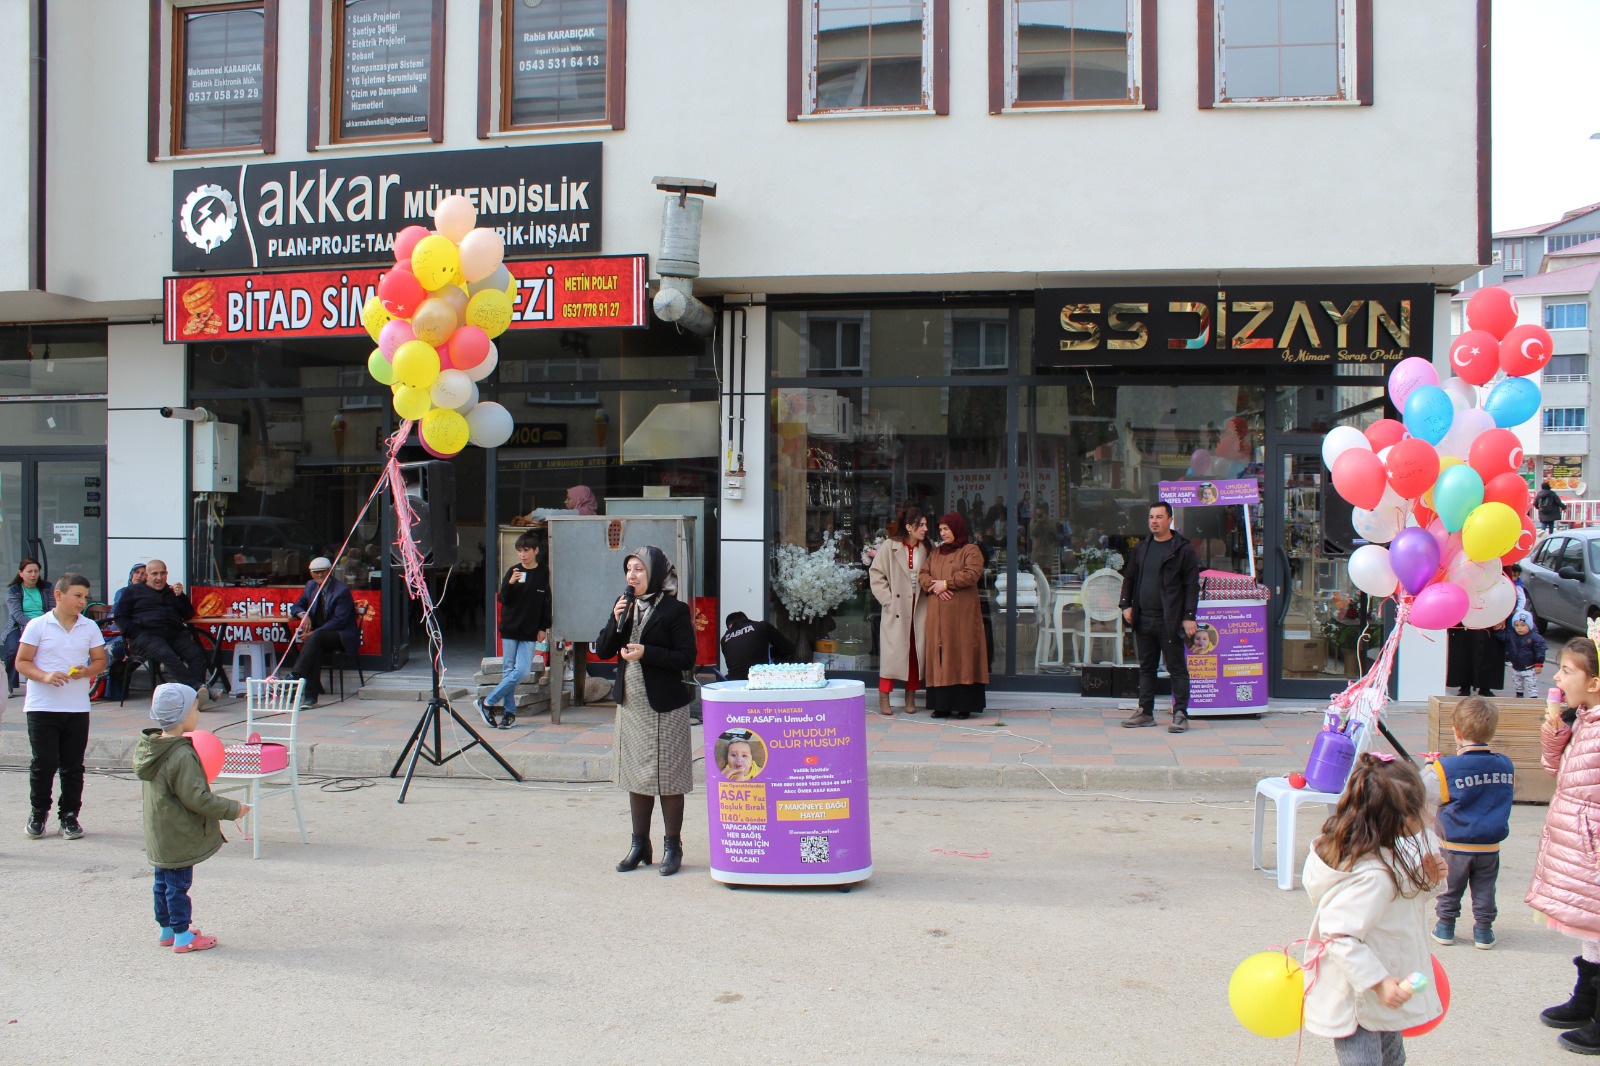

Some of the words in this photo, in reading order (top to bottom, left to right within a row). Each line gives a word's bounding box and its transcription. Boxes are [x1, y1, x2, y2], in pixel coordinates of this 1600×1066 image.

[352, 14, 372, 23] Statik
[373, 11, 400, 22] Projeleri
[352, 26, 376, 38] Şantiye
[524, 32, 546, 42] Rabia
[548, 28, 595, 40] KARABIÇAK
[352, 38, 376, 48] Elektrik
[378, 36, 406, 47] Projeleri
[352, 62, 398, 74] Kompanzasyon
[400, 59, 424, 69] Sistemi
[520, 60, 544, 72] 0543
[548, 58, 566, 70] 531
[570, 56, 583, 68] 64
[586, 55, 599, 66] 13
[188, 66, 222, 76] Muhammed
[224, 64, 262, 74] KARABIÇAK
[192, 80, 212, 88] Elektrik
[214, 78, 242, 86] Elektronik
[352, 77, 360, 86] YG
[362, 75, 386, 86] İşletme
[189, 92, 212, 102] 0537
[214, 90, 230, 100] 058
[234, 89, 244, 98] 29
[248, 88, 258, 98] 29
[351, 89, 368, 100] Çizim
[378, 85, 418, 97] Danışmanlık
[352, 100, 384, 110] Hizmetleri
[258, 168, 400, 226] akkar
[404, 176, 590, 219] MÜENDİSLİK
[564, 272, 590, 291] METİN
[592, 276, 618, 290] POLAT
[228, 279, 312, 332] BİTAD
[322, 274, 384, 329] SİM
[562, 304, 582, 318] 0537
[582, 302, 598, 318] 778
[599, 302, 608, 317] 91
[610, 302, 620, 317] 27
[1060, 302, 1149, 350] SS
[1168, 292, 1411, 350] DİZAYN
[1281, 348, 1294, 362] İç
[1293, 350, 1330, 362] Mimar
[1338, 350, 1368, 362] Serap
[1370, 349, 1404, 360] Polat
[724, 625, 754, 642] ZABITA
[726, 714, 751, 724] ÖMER
[784, 714, 814, 723] Umudu
[816, 714, 826, 722] Ol
[783, 728, 836, 738] UMUDUM
[770, 739, 801, 749] OLUR
[804, 737, 850, 748] MUSUN?
[1455, 772, 1514, 789] COLLEGE
[720, 790, 751, 801] ASAF
[720, 803, 743, 811] Boşluk
[784, 802, 824, 810] MAKİNEYE
[826, 800, 846, 809] BAĞLI
[722, 823, 766, 831] YAPACAĞINIZ
[741, 831, 762, 840] BAĞIŞ
[720, 839, 752, 848] YAŞAMAM
[754, 840, 770, 848] İÇİN
[730, 856, 760, 864] OLACAK!
